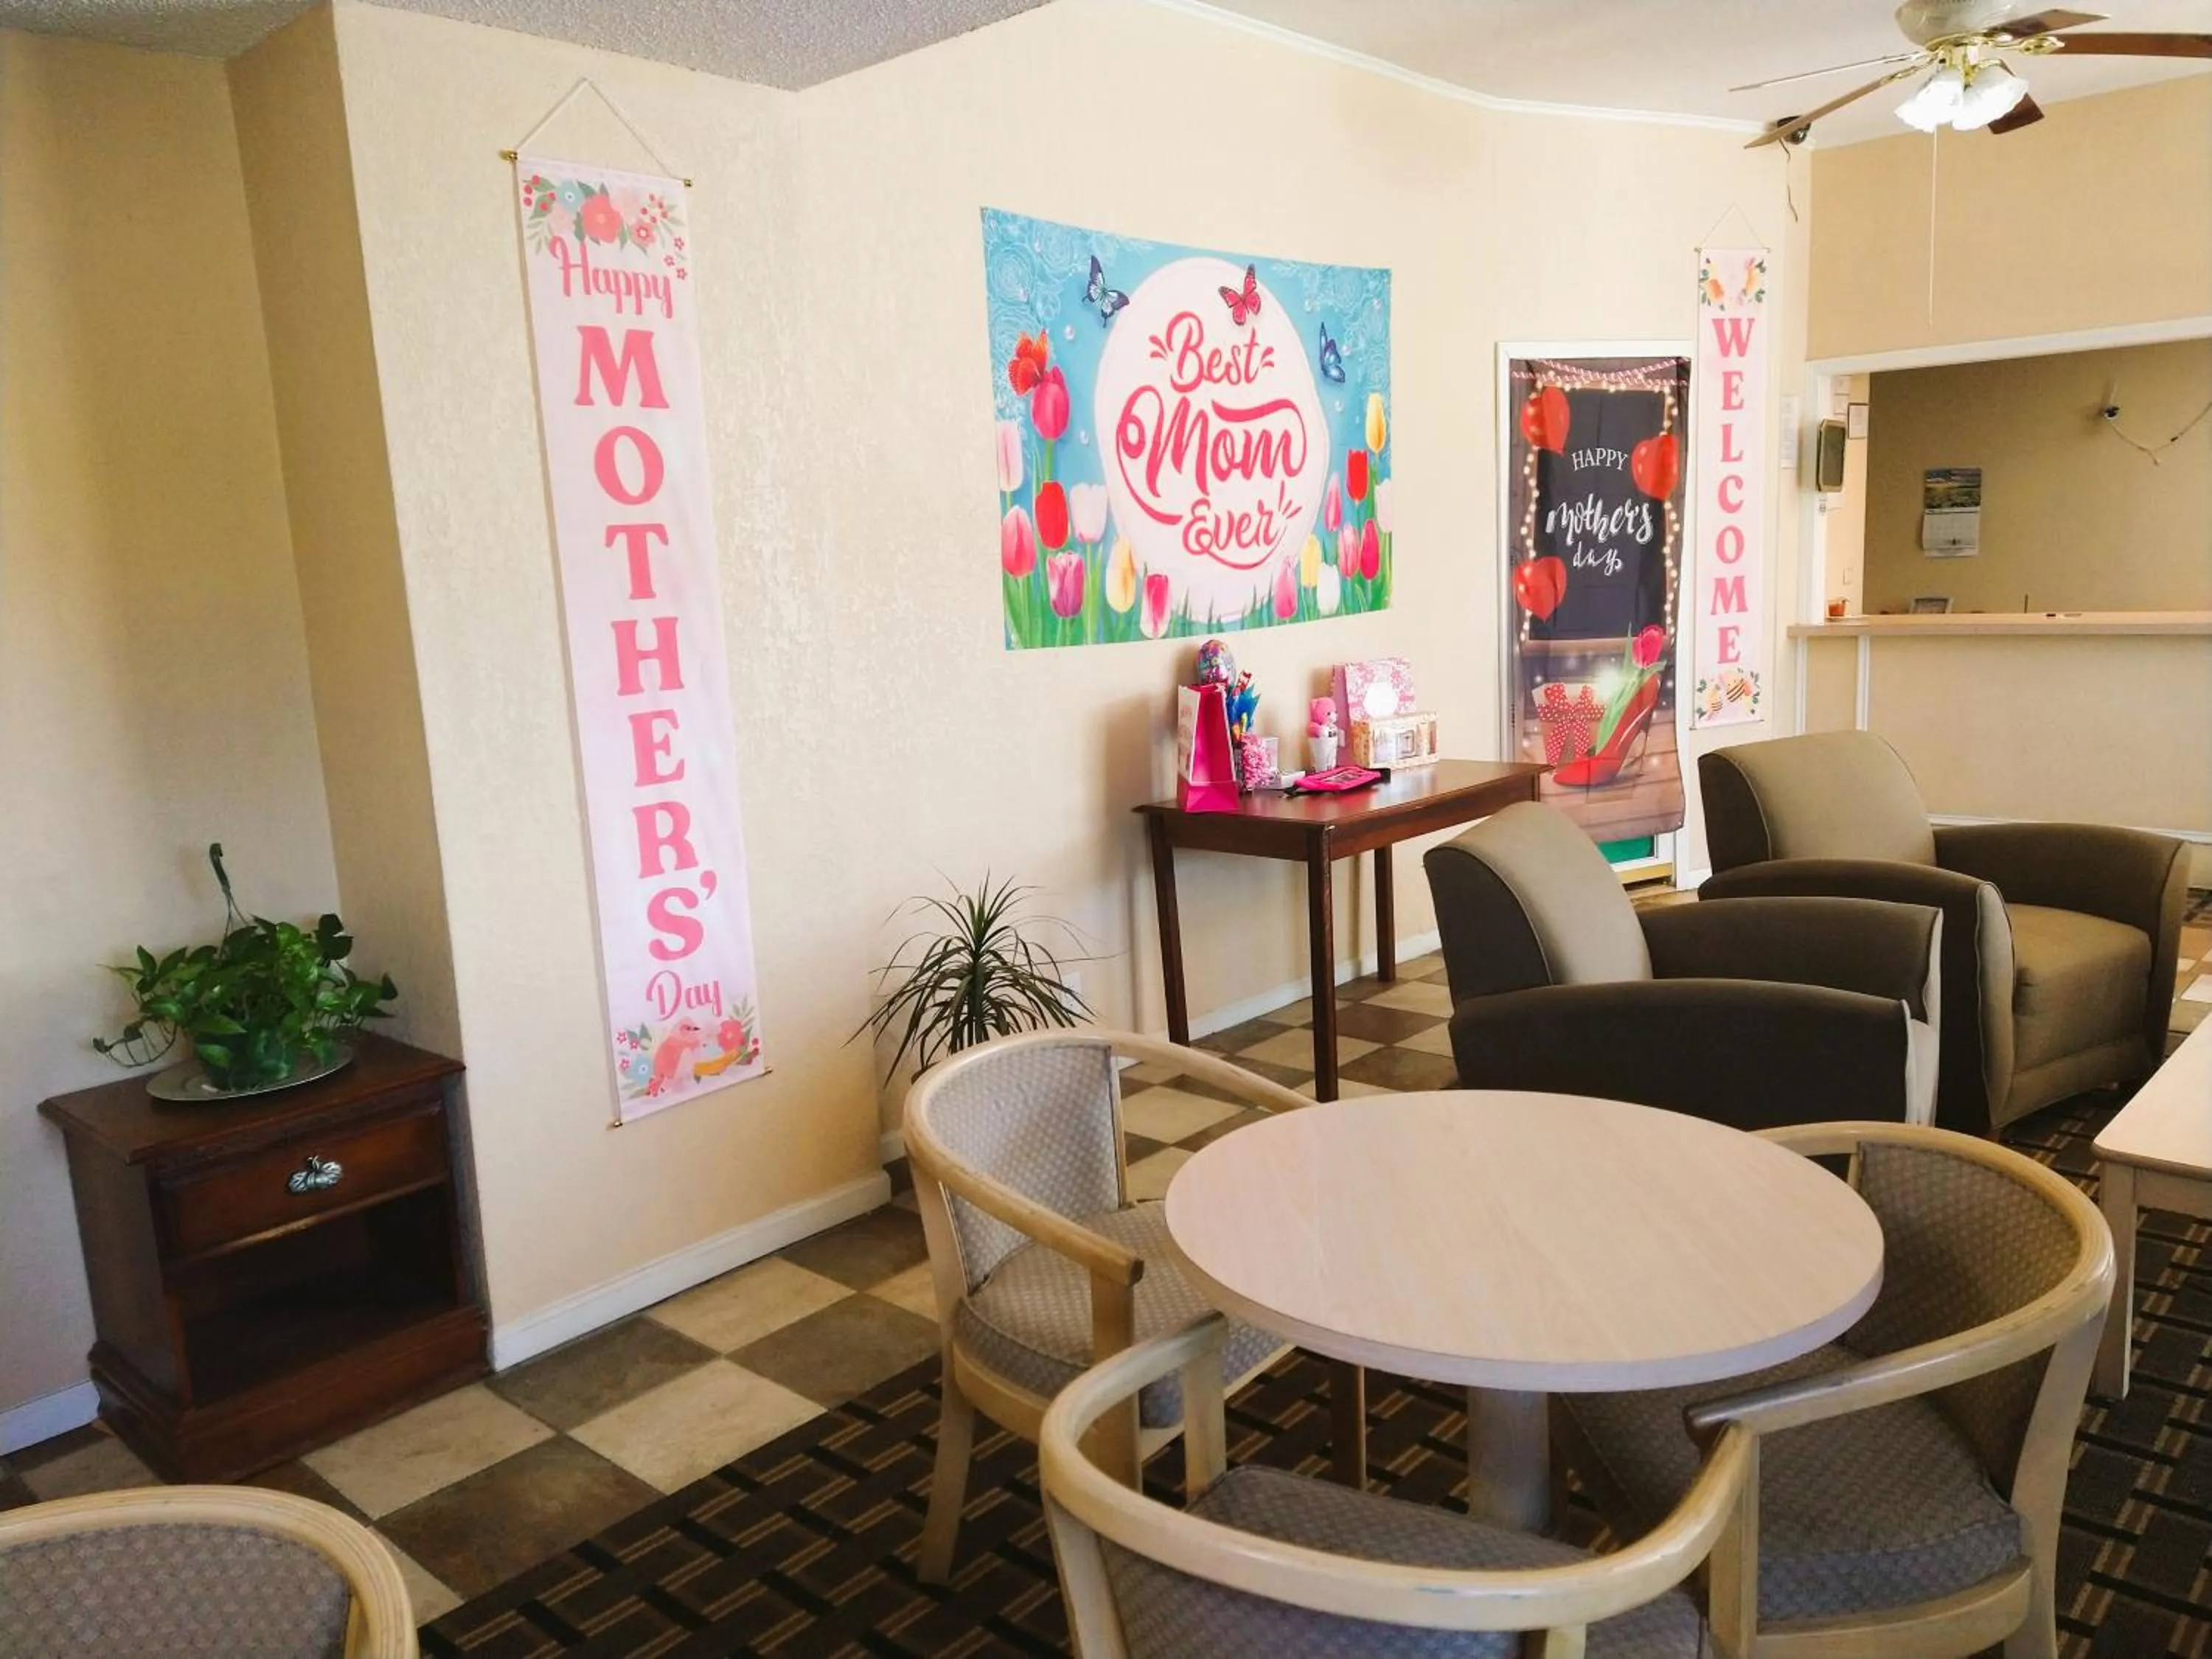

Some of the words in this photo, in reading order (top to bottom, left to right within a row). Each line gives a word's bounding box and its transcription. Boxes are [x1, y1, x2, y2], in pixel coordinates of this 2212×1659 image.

[549, 234, 674, 319] Happy
[1165, 310, 1259, 392] Best
[1116, 385, 1307, 526] Mom
[1571, 448, 1628, 471] HAPPY
[1710, 317, 1755, 664] WELCOME
[1182, 499, 1287, 570] Ever
[1572, 541, 1624, 576] day
[573, 325, 718, 960] MOTHER'S
[645, 970, 723, 1021] Day
